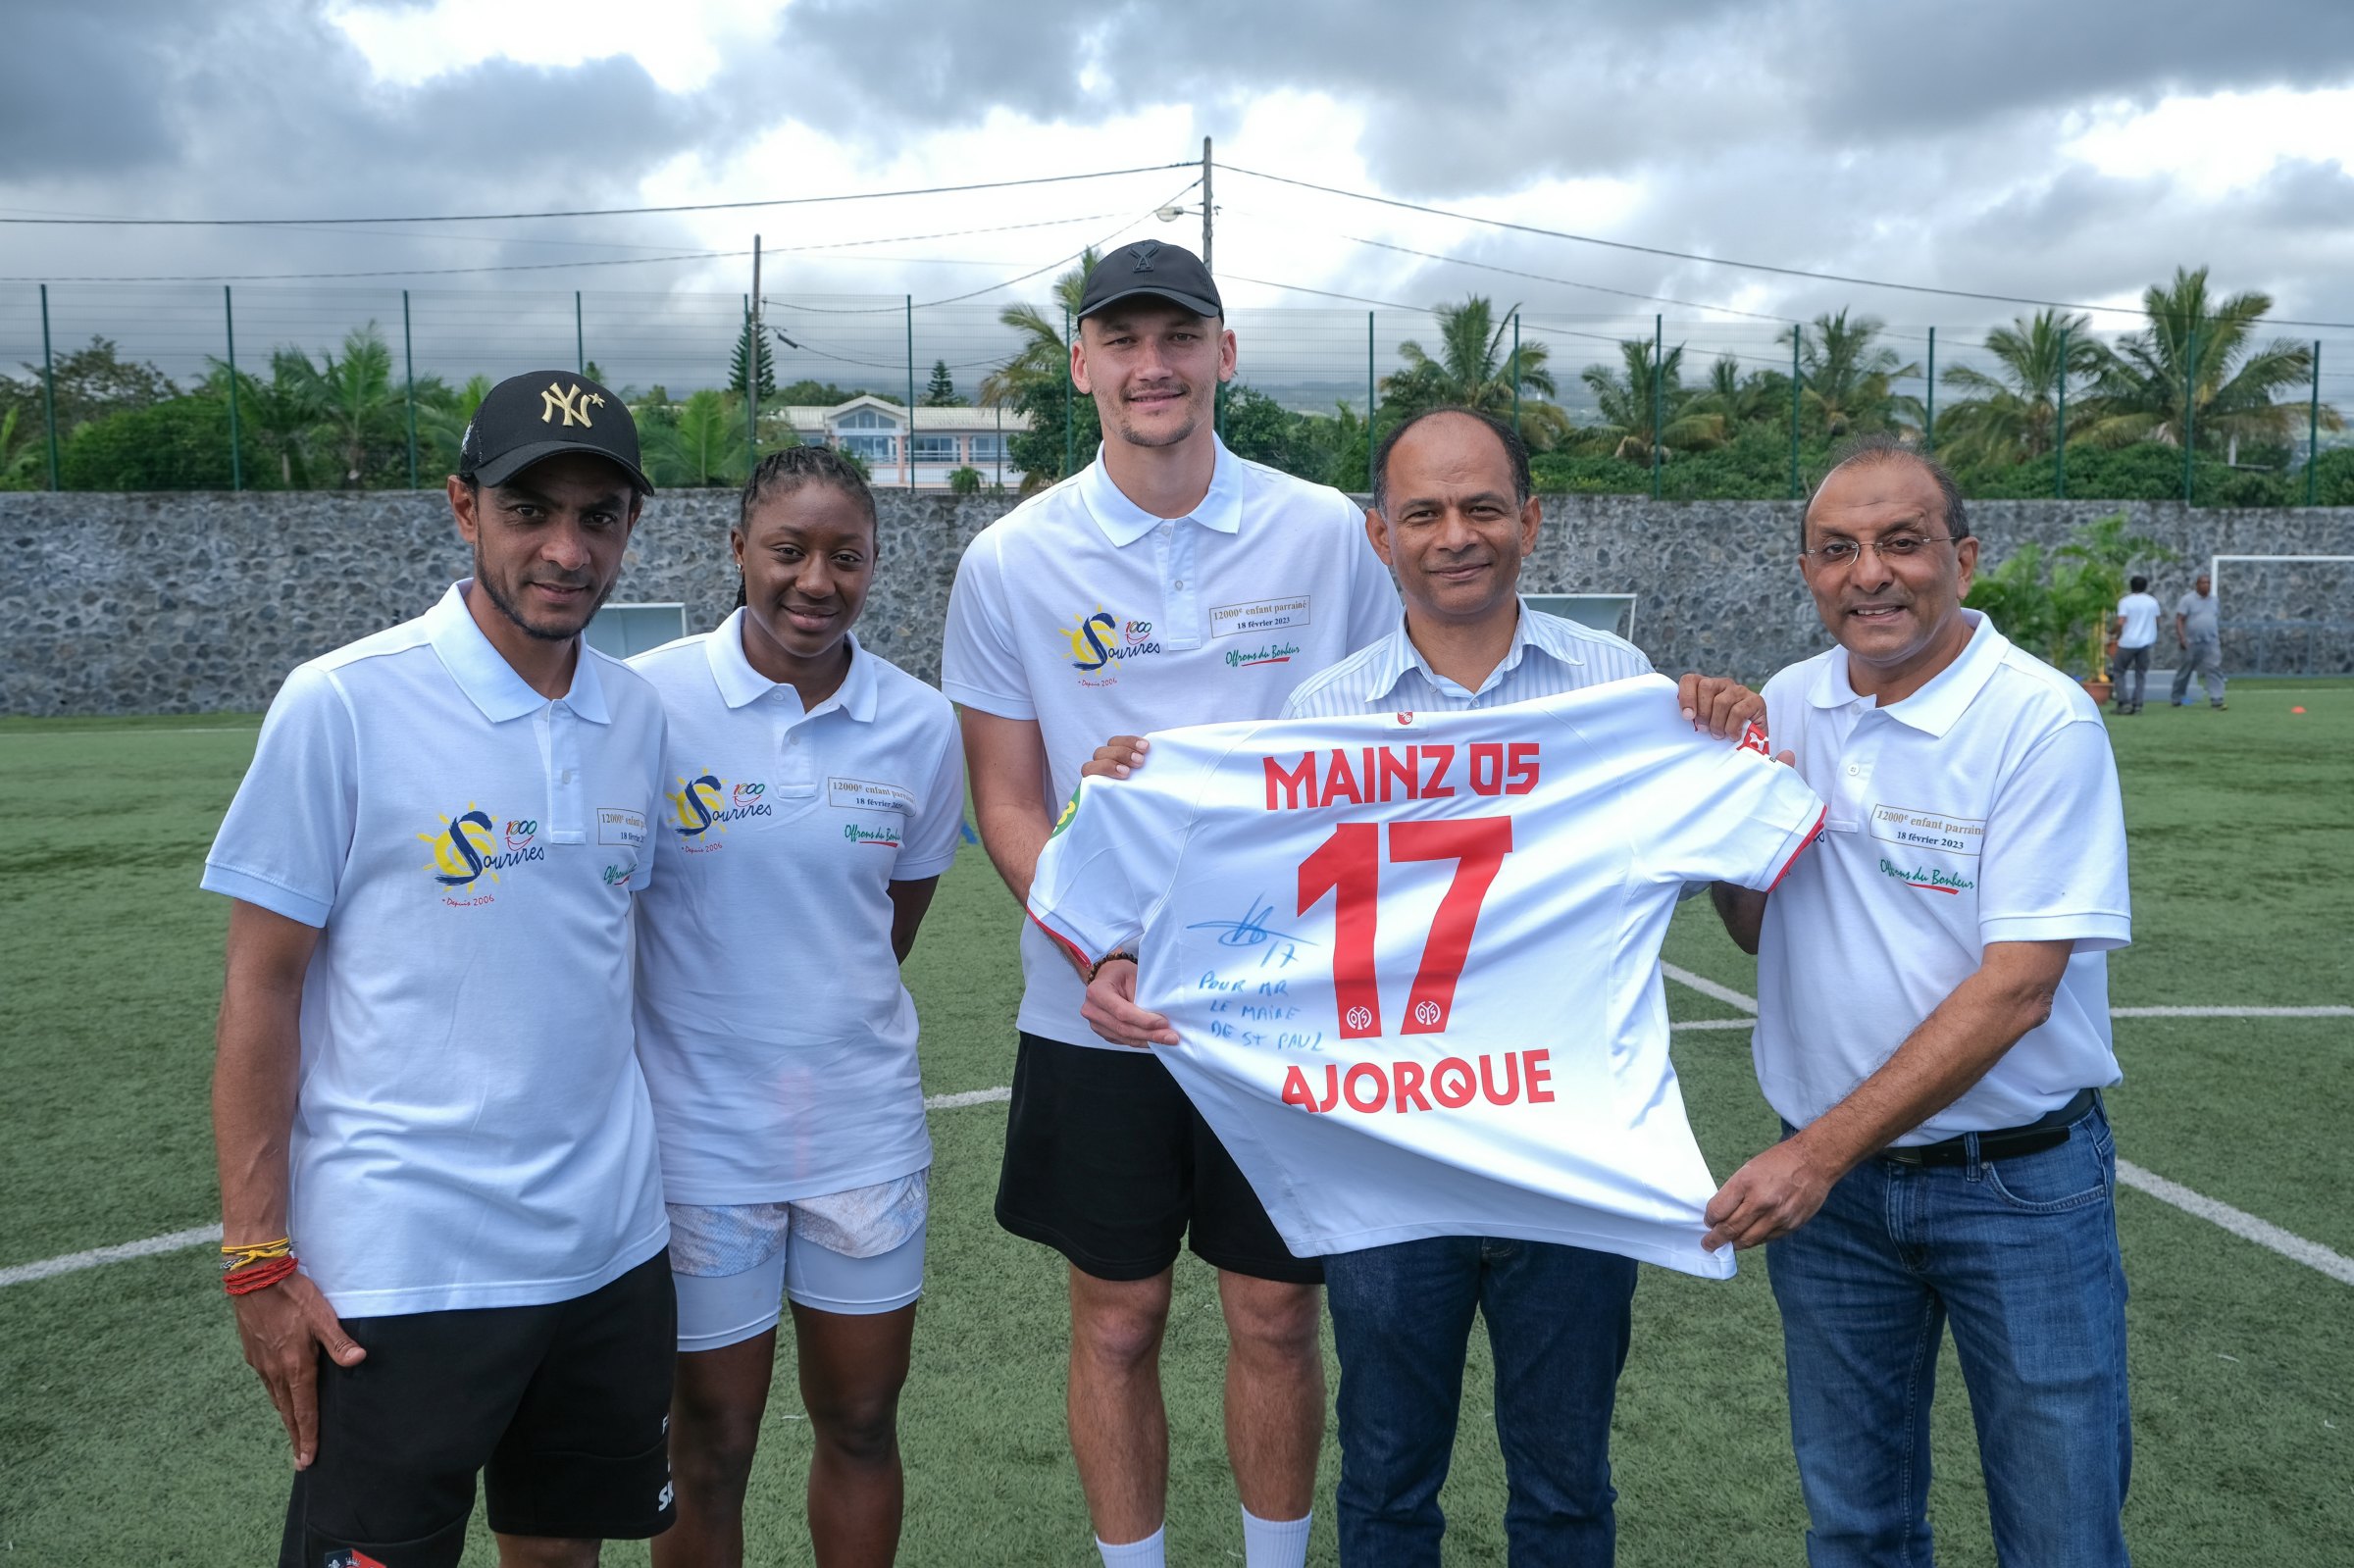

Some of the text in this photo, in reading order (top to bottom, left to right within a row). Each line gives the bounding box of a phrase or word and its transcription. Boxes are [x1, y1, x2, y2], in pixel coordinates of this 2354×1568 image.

[1246, 605, 1273, 616] enfant
[1274, 599, 1307, 614] parrainé
[1248, 619, 1273, 629] février
[1274, 617, 1291, 626] 2023
[1225, 641, 1301, 668] Offrons du Bonheur
[1262, 742, 1540, 811] MAINZ 05
[865, 785, 891, 796] enfant
[867, 798, 891, 808] février
[1910, 816, 1943, 831] enfant
[620, 832, 628, 840] 18
[844, 824, 874, 842] Offrons
[1896, 831, 1965, 850] 18 février 2023
[1912, 866, 1928, 883] du
[1931, 869, 1975, 890] Bonheur
[473, 893, 494, 906] 2006
[1297, 815, 1513, 1039] 17
[1281, 1048, 1556, 1115] AJORQUE
